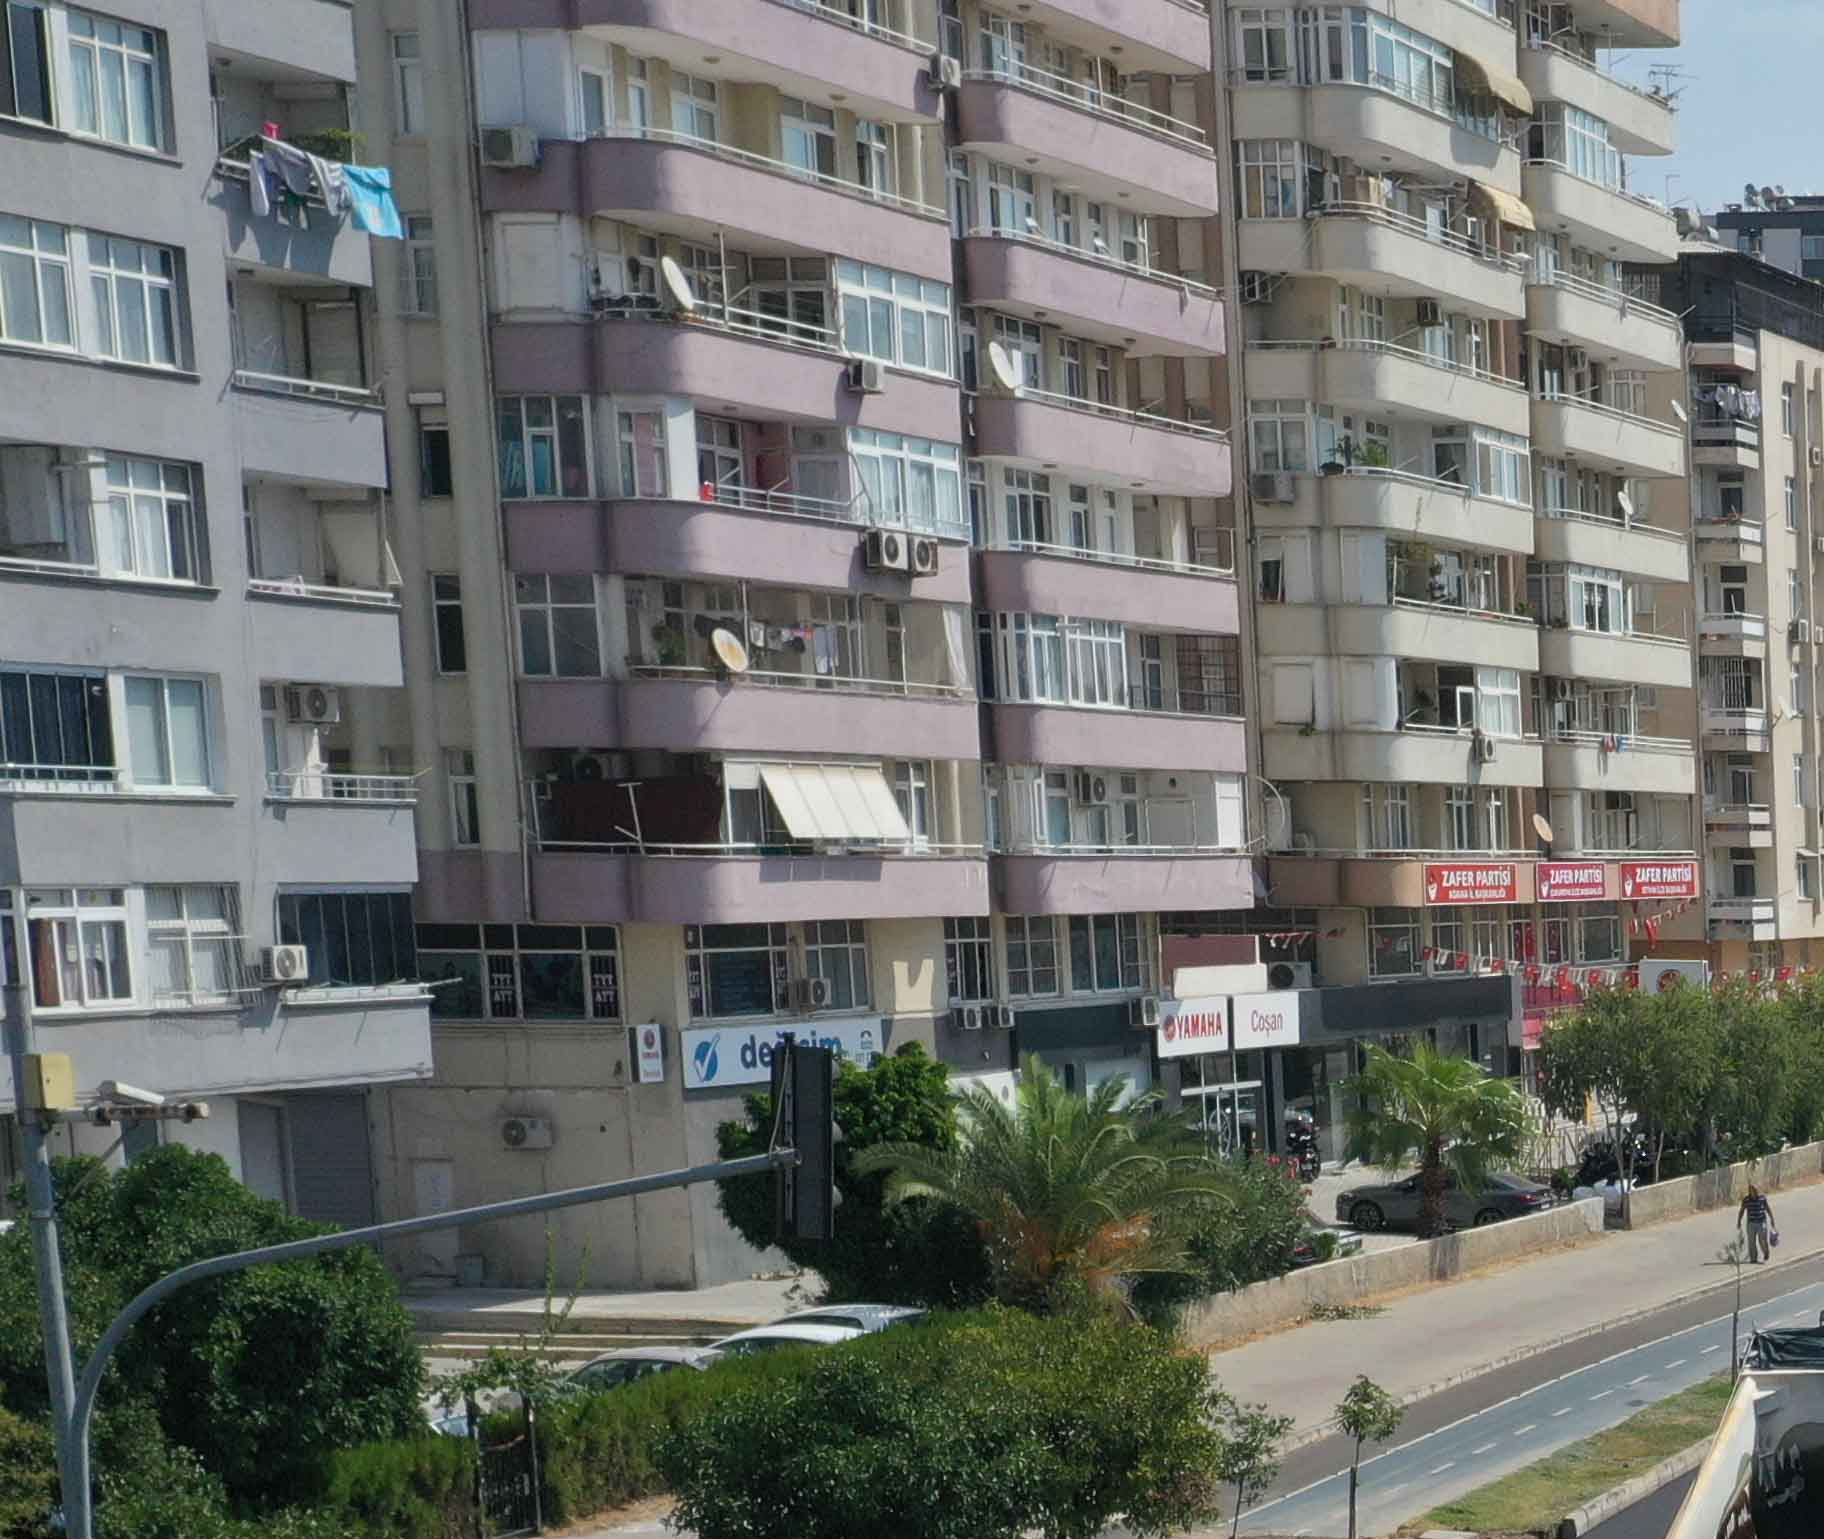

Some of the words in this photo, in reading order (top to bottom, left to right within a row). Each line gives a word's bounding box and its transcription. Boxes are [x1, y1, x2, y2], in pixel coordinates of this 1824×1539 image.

[1441, 870, 1474, 887] ZAFER
[1476, 865, 1511, 887] PARTİSİ
[1550, 869, 1574, 884] ZAFER
[1575, 865, 1603, 883] PARTİSİ
[1636, 867, 1661, 883] ZAFER
[1662, 863, 1692, 882] PARTİSİ
[1177, 1012, 1223, 1040] YAMAHA
[1251, 1009, 1284, 1038] Coşan
